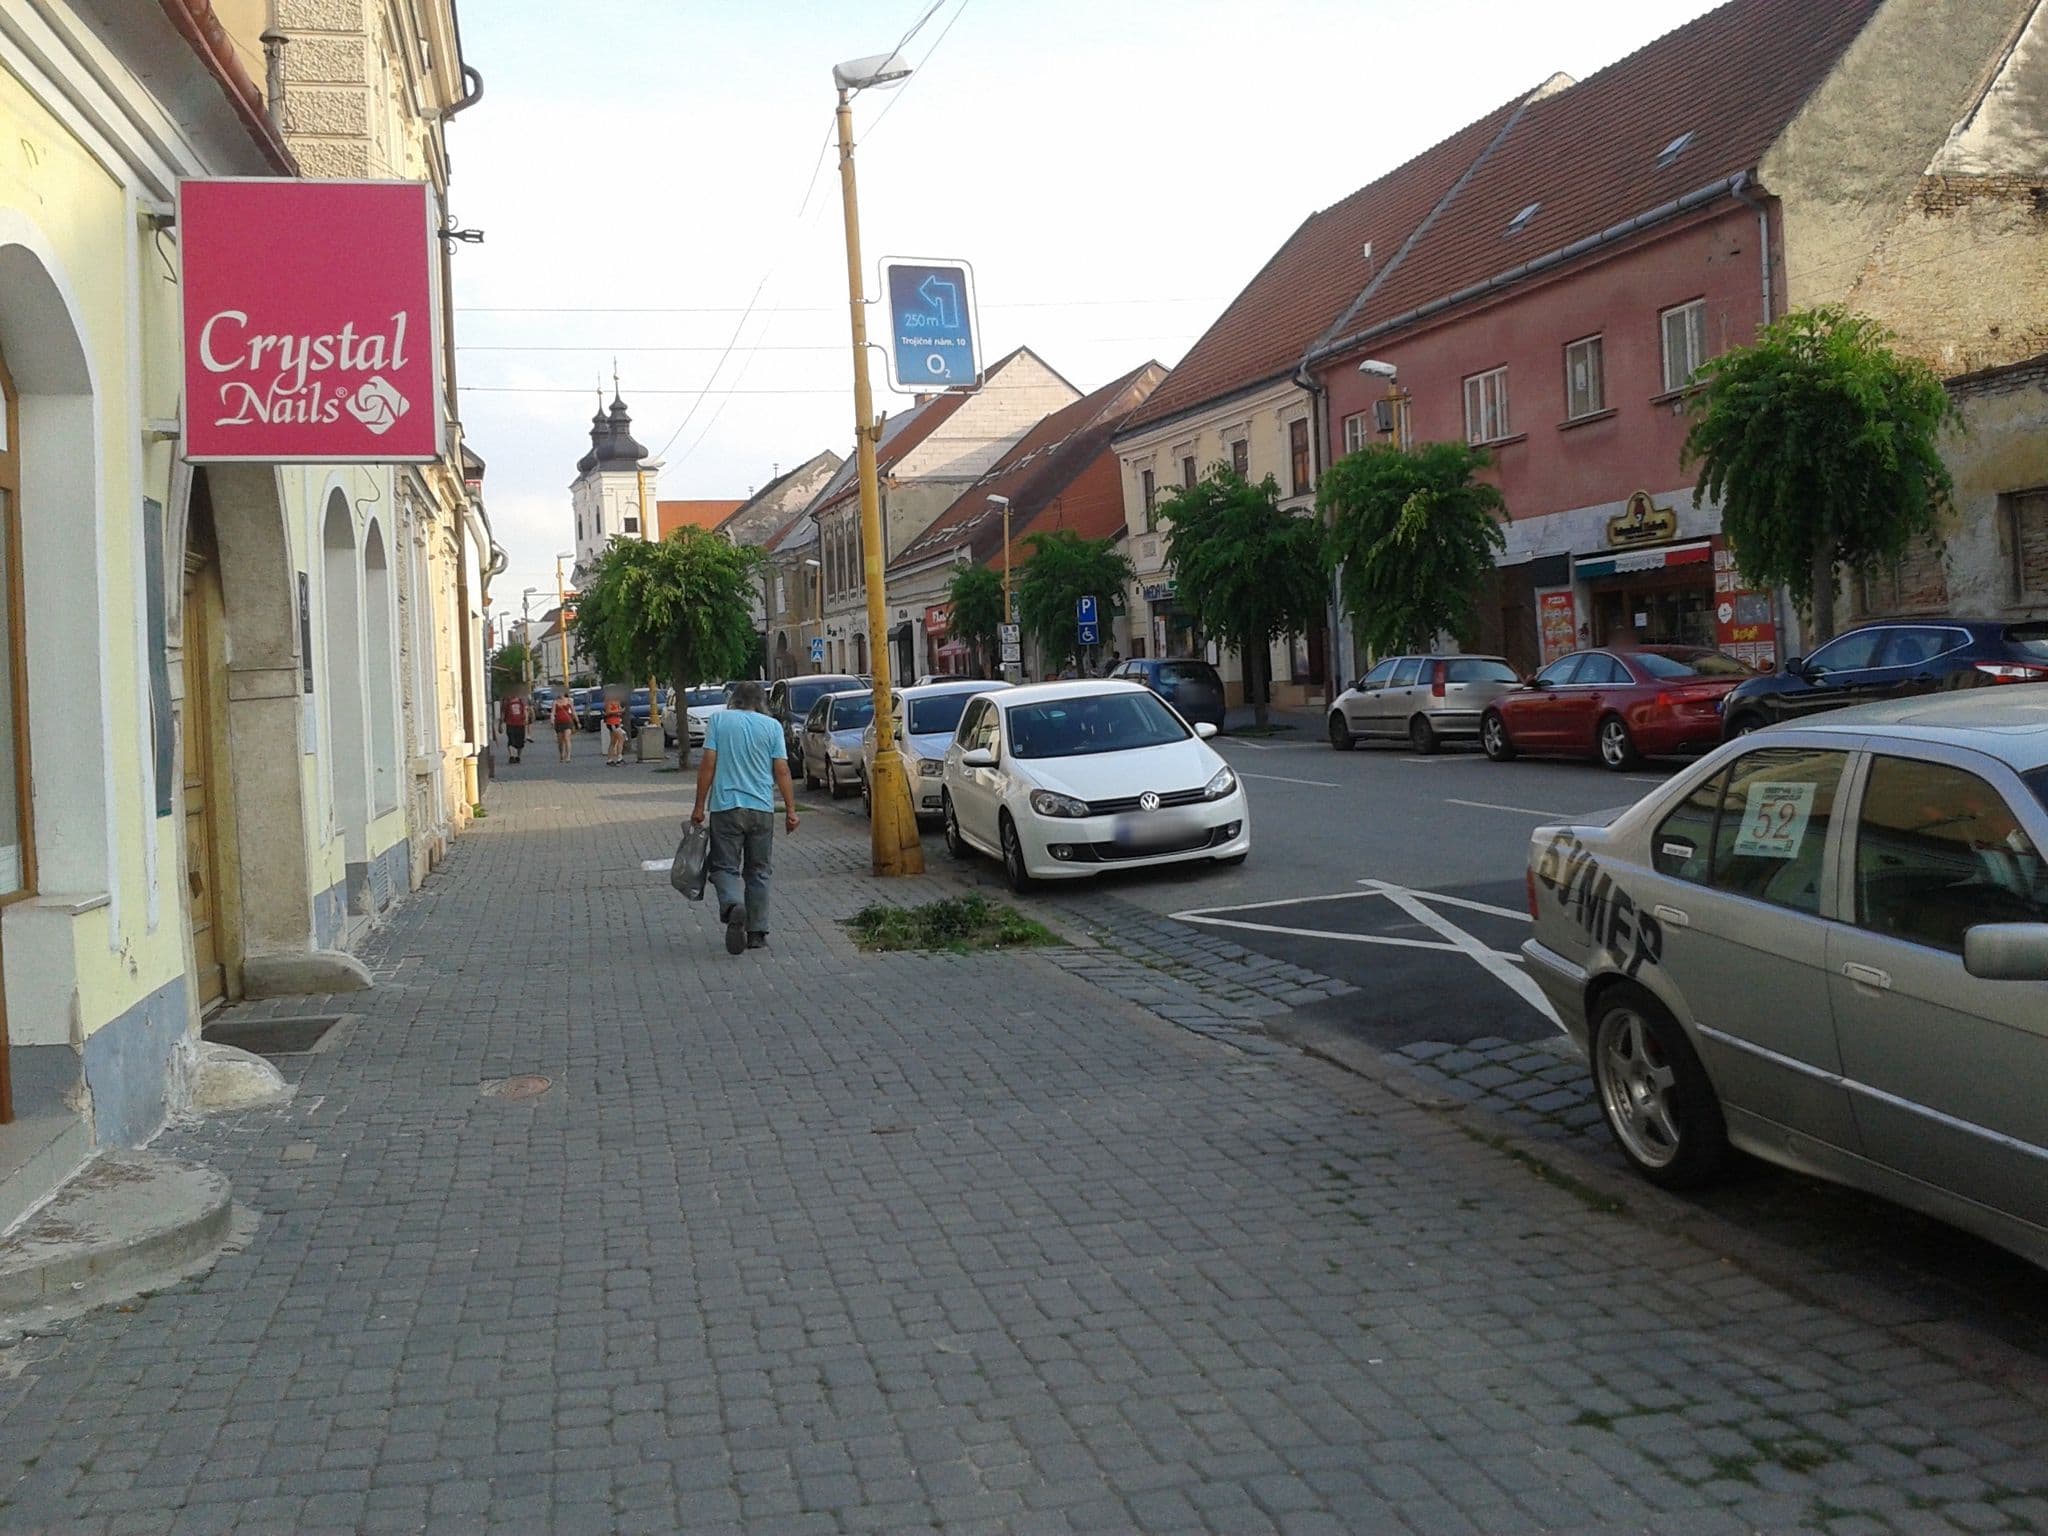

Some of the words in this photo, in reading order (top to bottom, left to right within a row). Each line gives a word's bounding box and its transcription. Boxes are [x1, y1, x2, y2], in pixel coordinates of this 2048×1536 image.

[905, 313, 925, 327] 250
[926, 315, 939, 327] m
[199, 310, 409, 394] Crystal
[1082, 599, 1091, 614] P
[1752, 802, 1797, 839] 52
